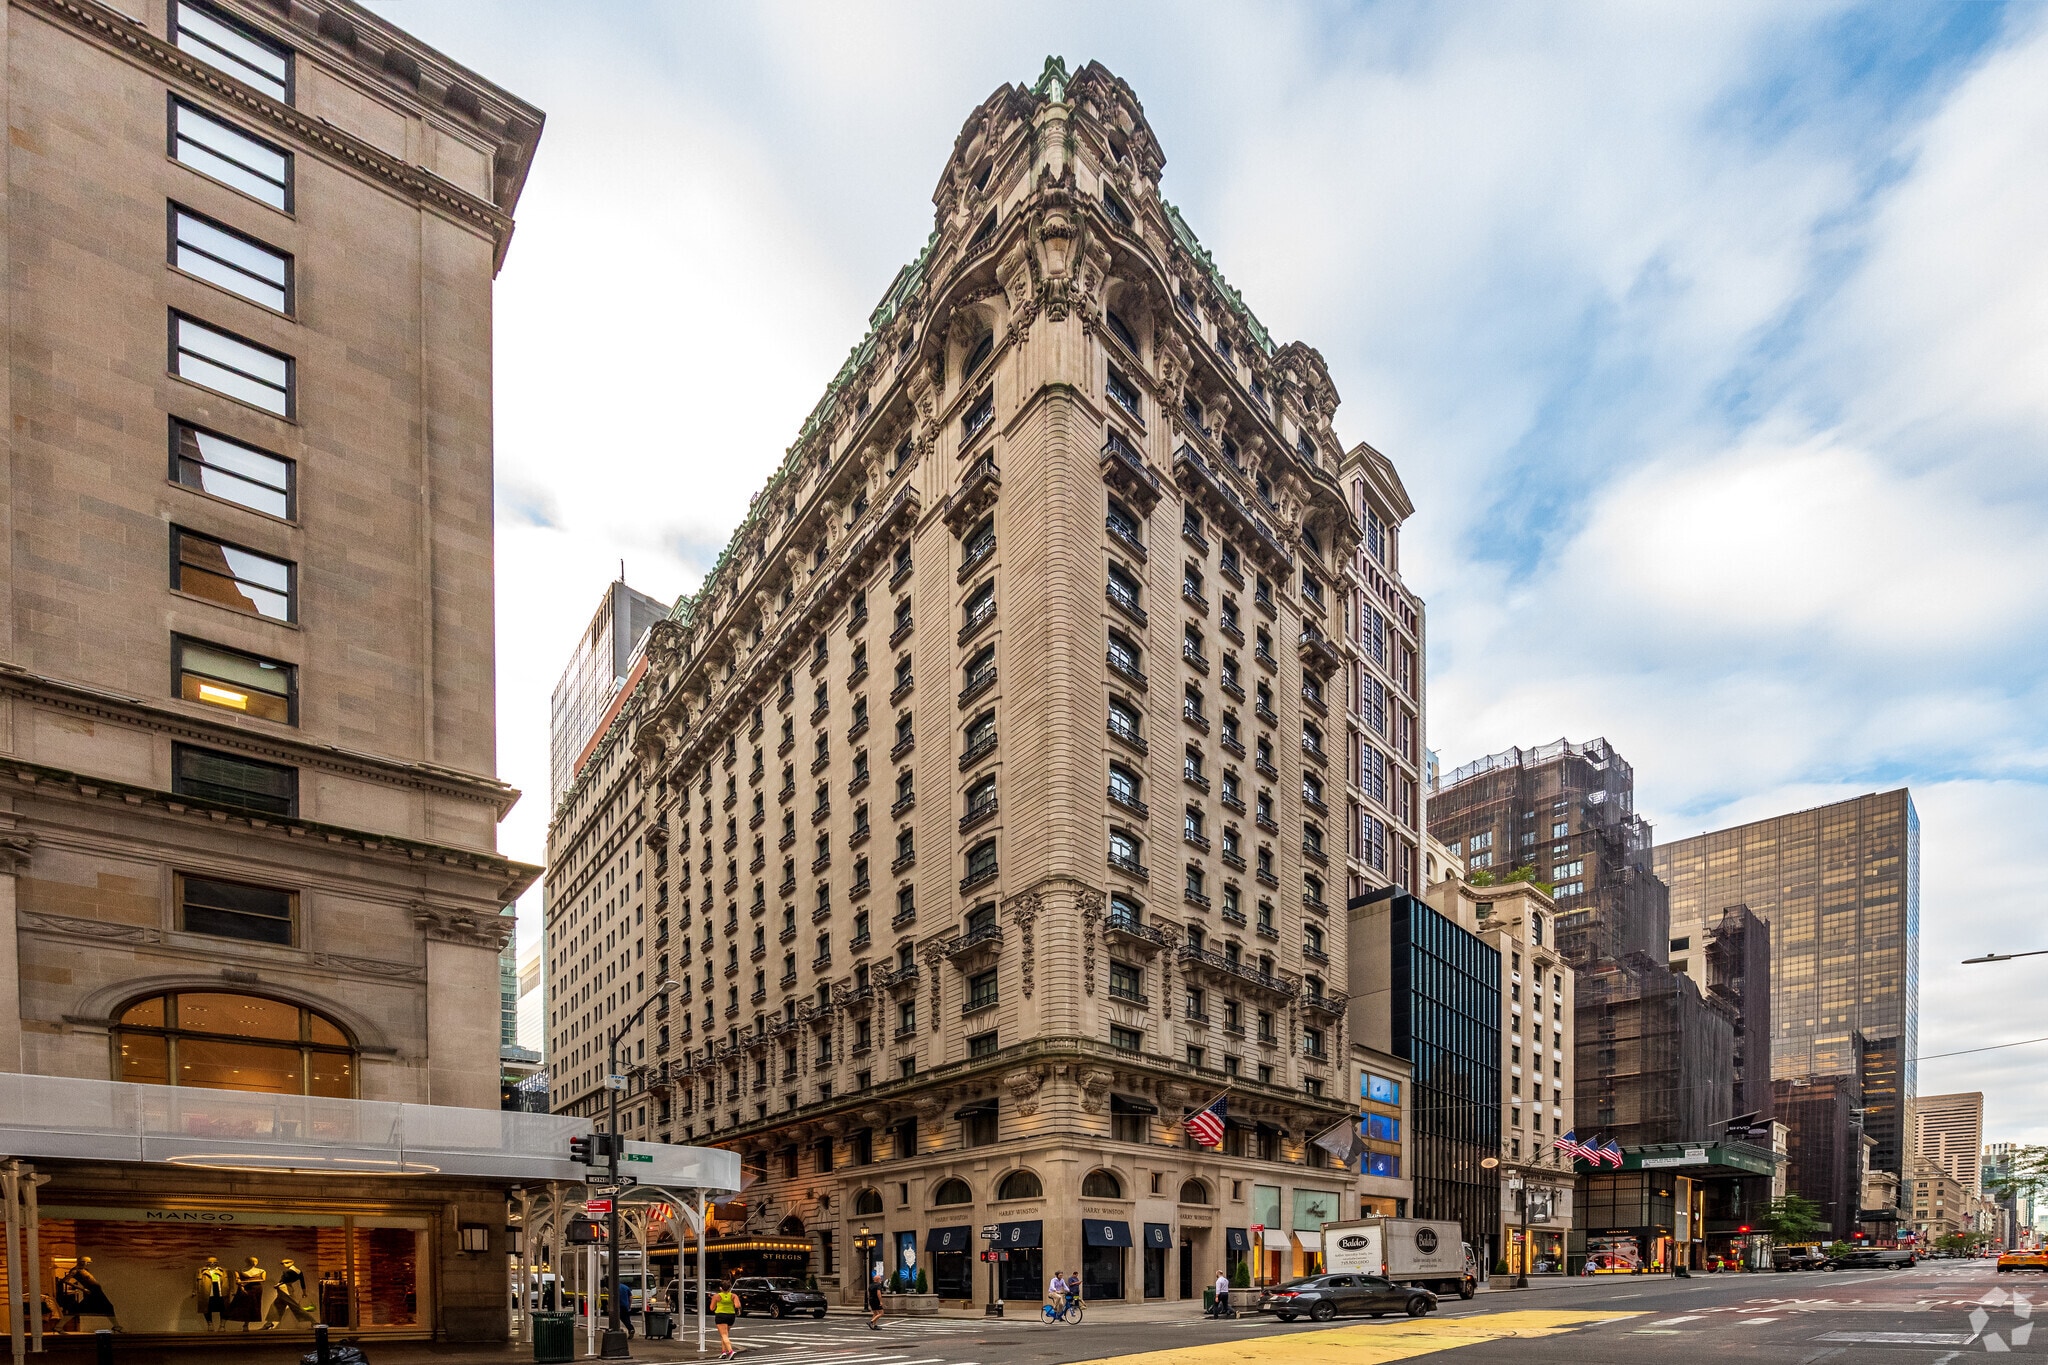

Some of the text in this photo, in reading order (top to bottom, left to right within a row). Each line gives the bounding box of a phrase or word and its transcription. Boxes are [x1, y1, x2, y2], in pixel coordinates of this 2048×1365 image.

[146, 1211, 234, 1221] MANGO
[1016, 1207, 1039, 1215] WINSTON
[1342, 1238, 1367, 1248] Baldor
[1419, 1233, 1437, 1247] Baldor
